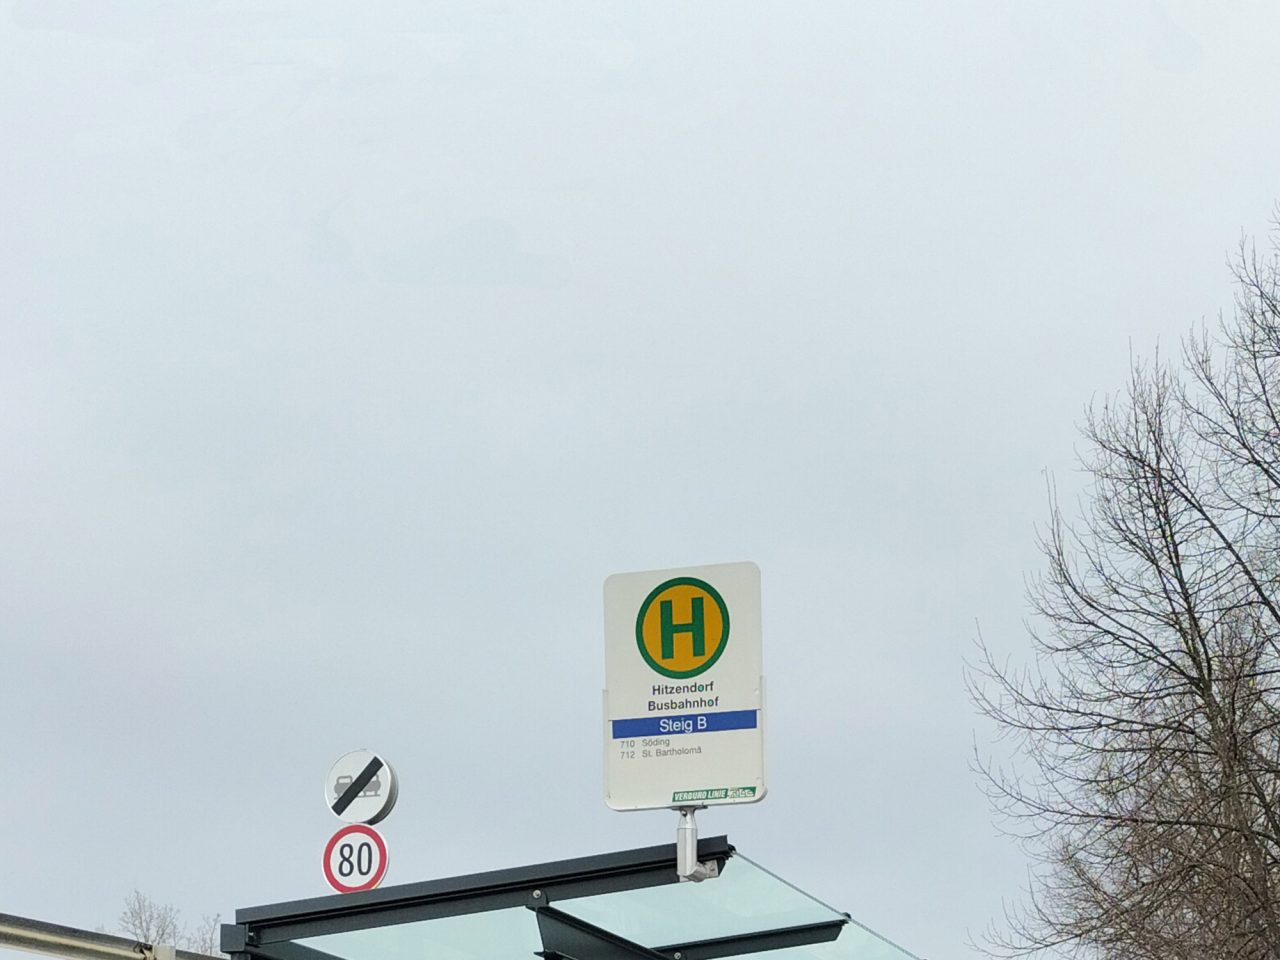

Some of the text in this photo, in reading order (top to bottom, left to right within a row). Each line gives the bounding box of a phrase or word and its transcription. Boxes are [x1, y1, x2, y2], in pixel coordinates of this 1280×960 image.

[660, 597, 705, 660] H
[652, 681, 714, 696] Hitzendorf
[648, 696, 719, 711] Busbahnhof
[659, 716, 707, 733] Steig B
[620, 740, 636, 748] 710
[620, 751, 636, 759] 712
[338, 842, 373, 877] 80
